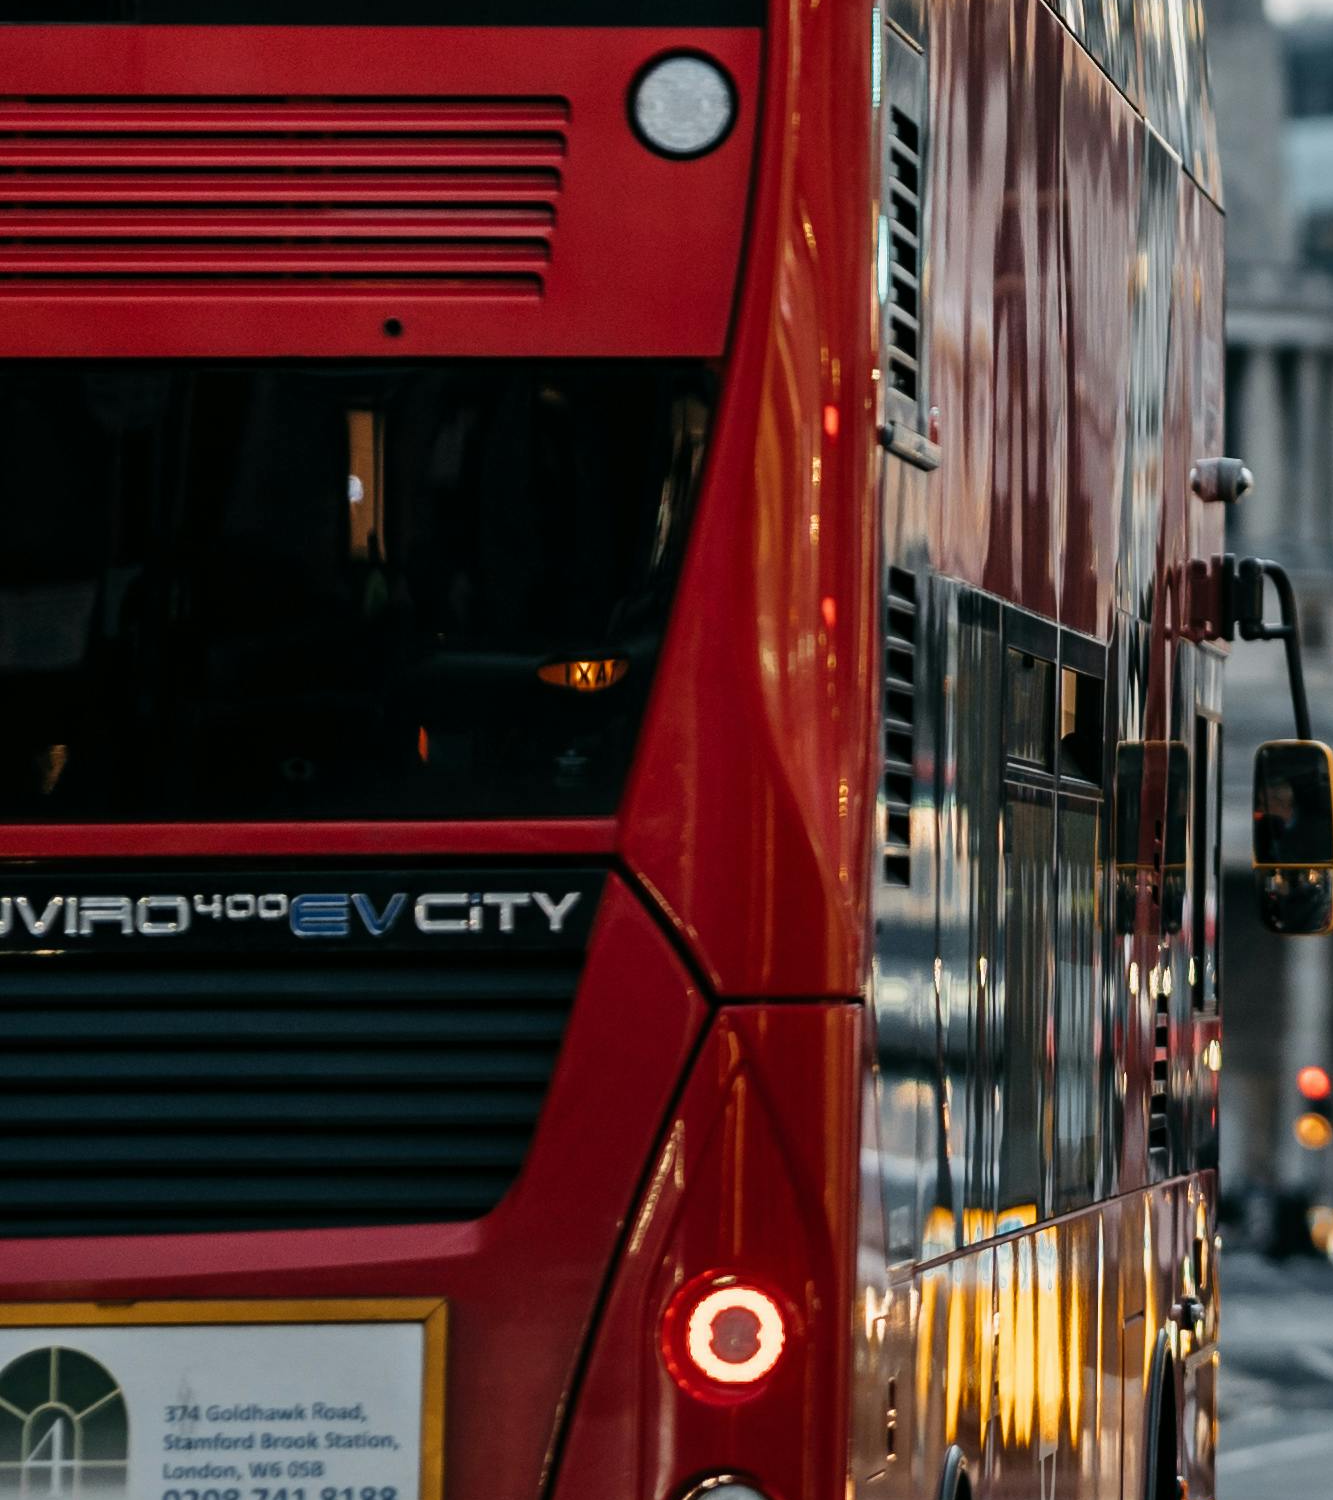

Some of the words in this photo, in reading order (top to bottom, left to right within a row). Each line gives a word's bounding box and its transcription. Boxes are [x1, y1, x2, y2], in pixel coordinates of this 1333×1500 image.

[165, 1404, 200, 1423] 374
[206, 1403, 306, 1423] Goldhawk
[312, 1401, 368, 1424] Road,
[162, 1431, 255, 1451] Stamford
[260, 1431, 319, 1450] Brook
[324, 1430, 400, 1452] Station,
[162, 1460, 243, 1482] London,
[248, 1460, 283, 1479] W6
